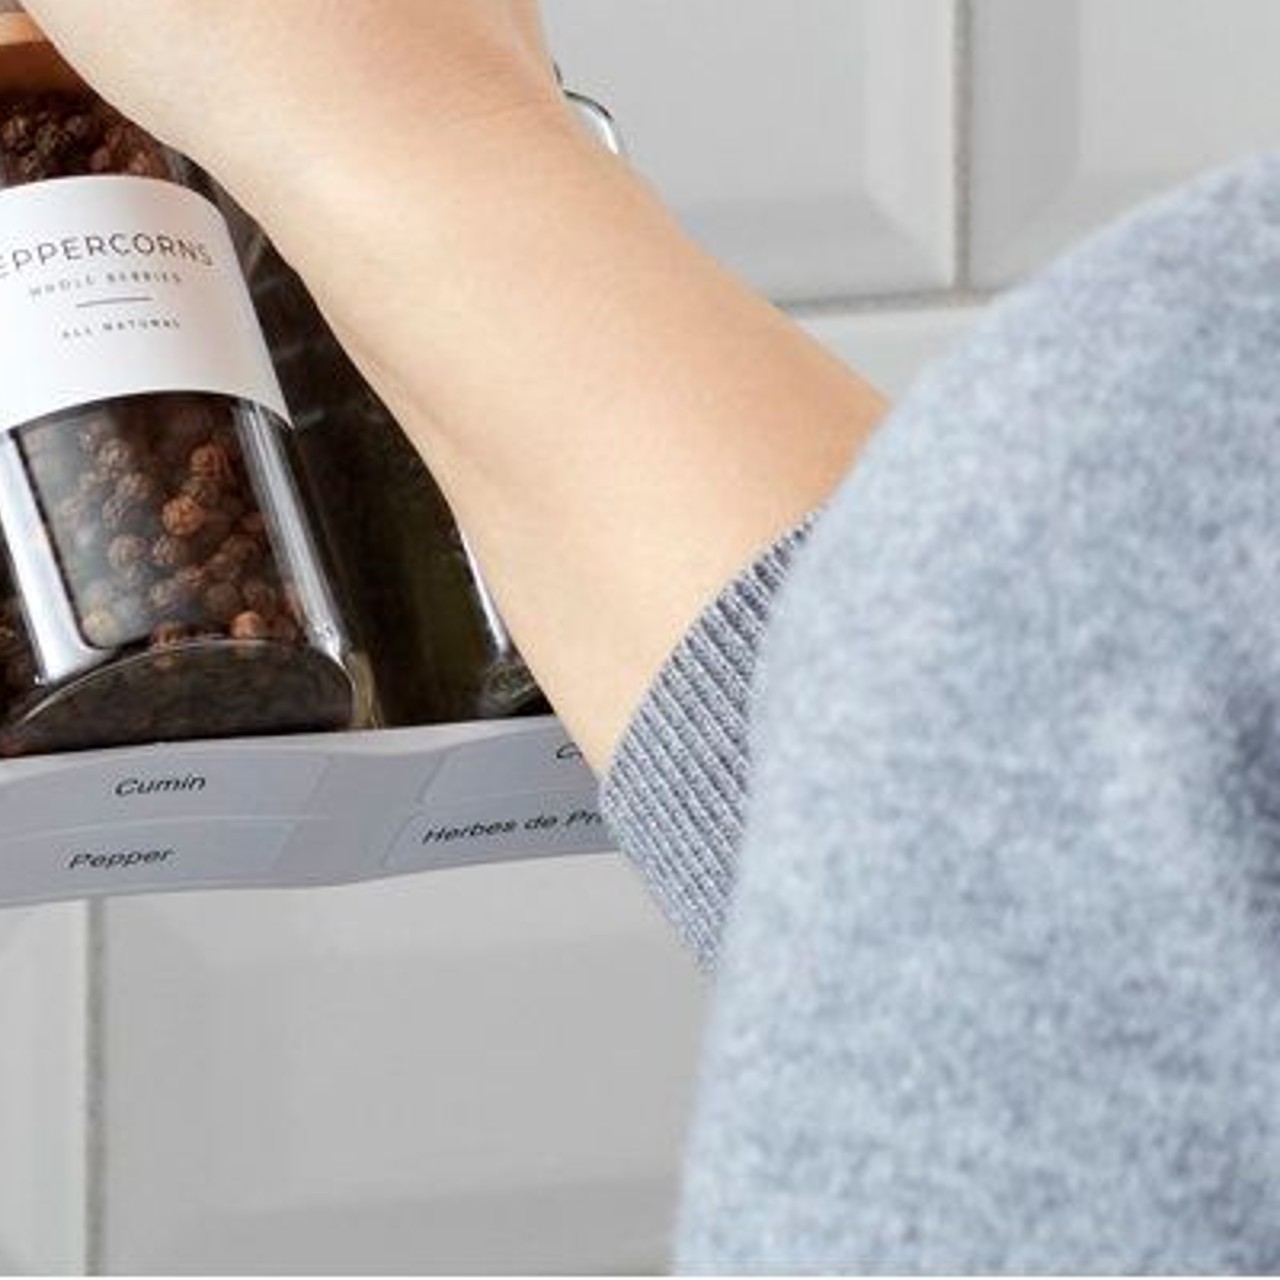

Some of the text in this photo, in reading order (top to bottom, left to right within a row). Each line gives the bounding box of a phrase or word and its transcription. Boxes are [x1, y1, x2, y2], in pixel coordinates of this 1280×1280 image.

[114, 774, 207, 798] Cumin
[421, 818, 518, 844] Herbes
[523, 813, 559, 831] de
[66, 848, 174, 872] Pepper
